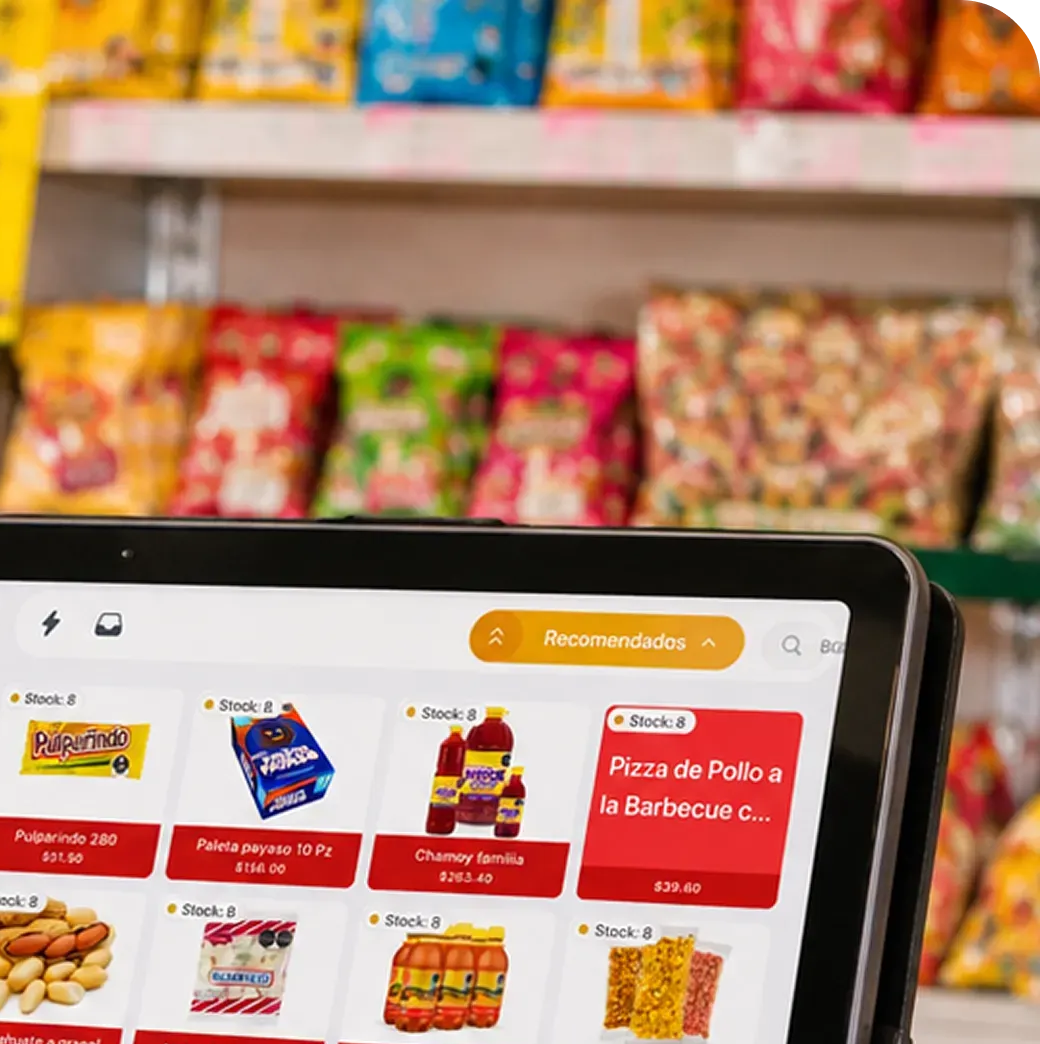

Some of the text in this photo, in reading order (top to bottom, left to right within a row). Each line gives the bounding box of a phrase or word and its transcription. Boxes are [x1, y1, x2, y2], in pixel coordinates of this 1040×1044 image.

[543, 629, 687, 651] Recomendados
[422, 705, 478, 722] Stock: 8
[629, 713, 686, 730] Stock: 8
[608, 756, 783, 784] Pizza de Pollo a
[599, 794, 619, 816] la
[625, 796, 733, 821] Barbecue
[14, 829, 118, 848] Pulparindo 280
[196, 838, 333, 859] Paleta payaso 10 Pz
[414, 848, 474, 867] Chamoy
[181, 903, 236, 919] Stock: 8
[384, 913, 441, 930] Stock: 8
[594, 923, 653, 940] Stock: 8
